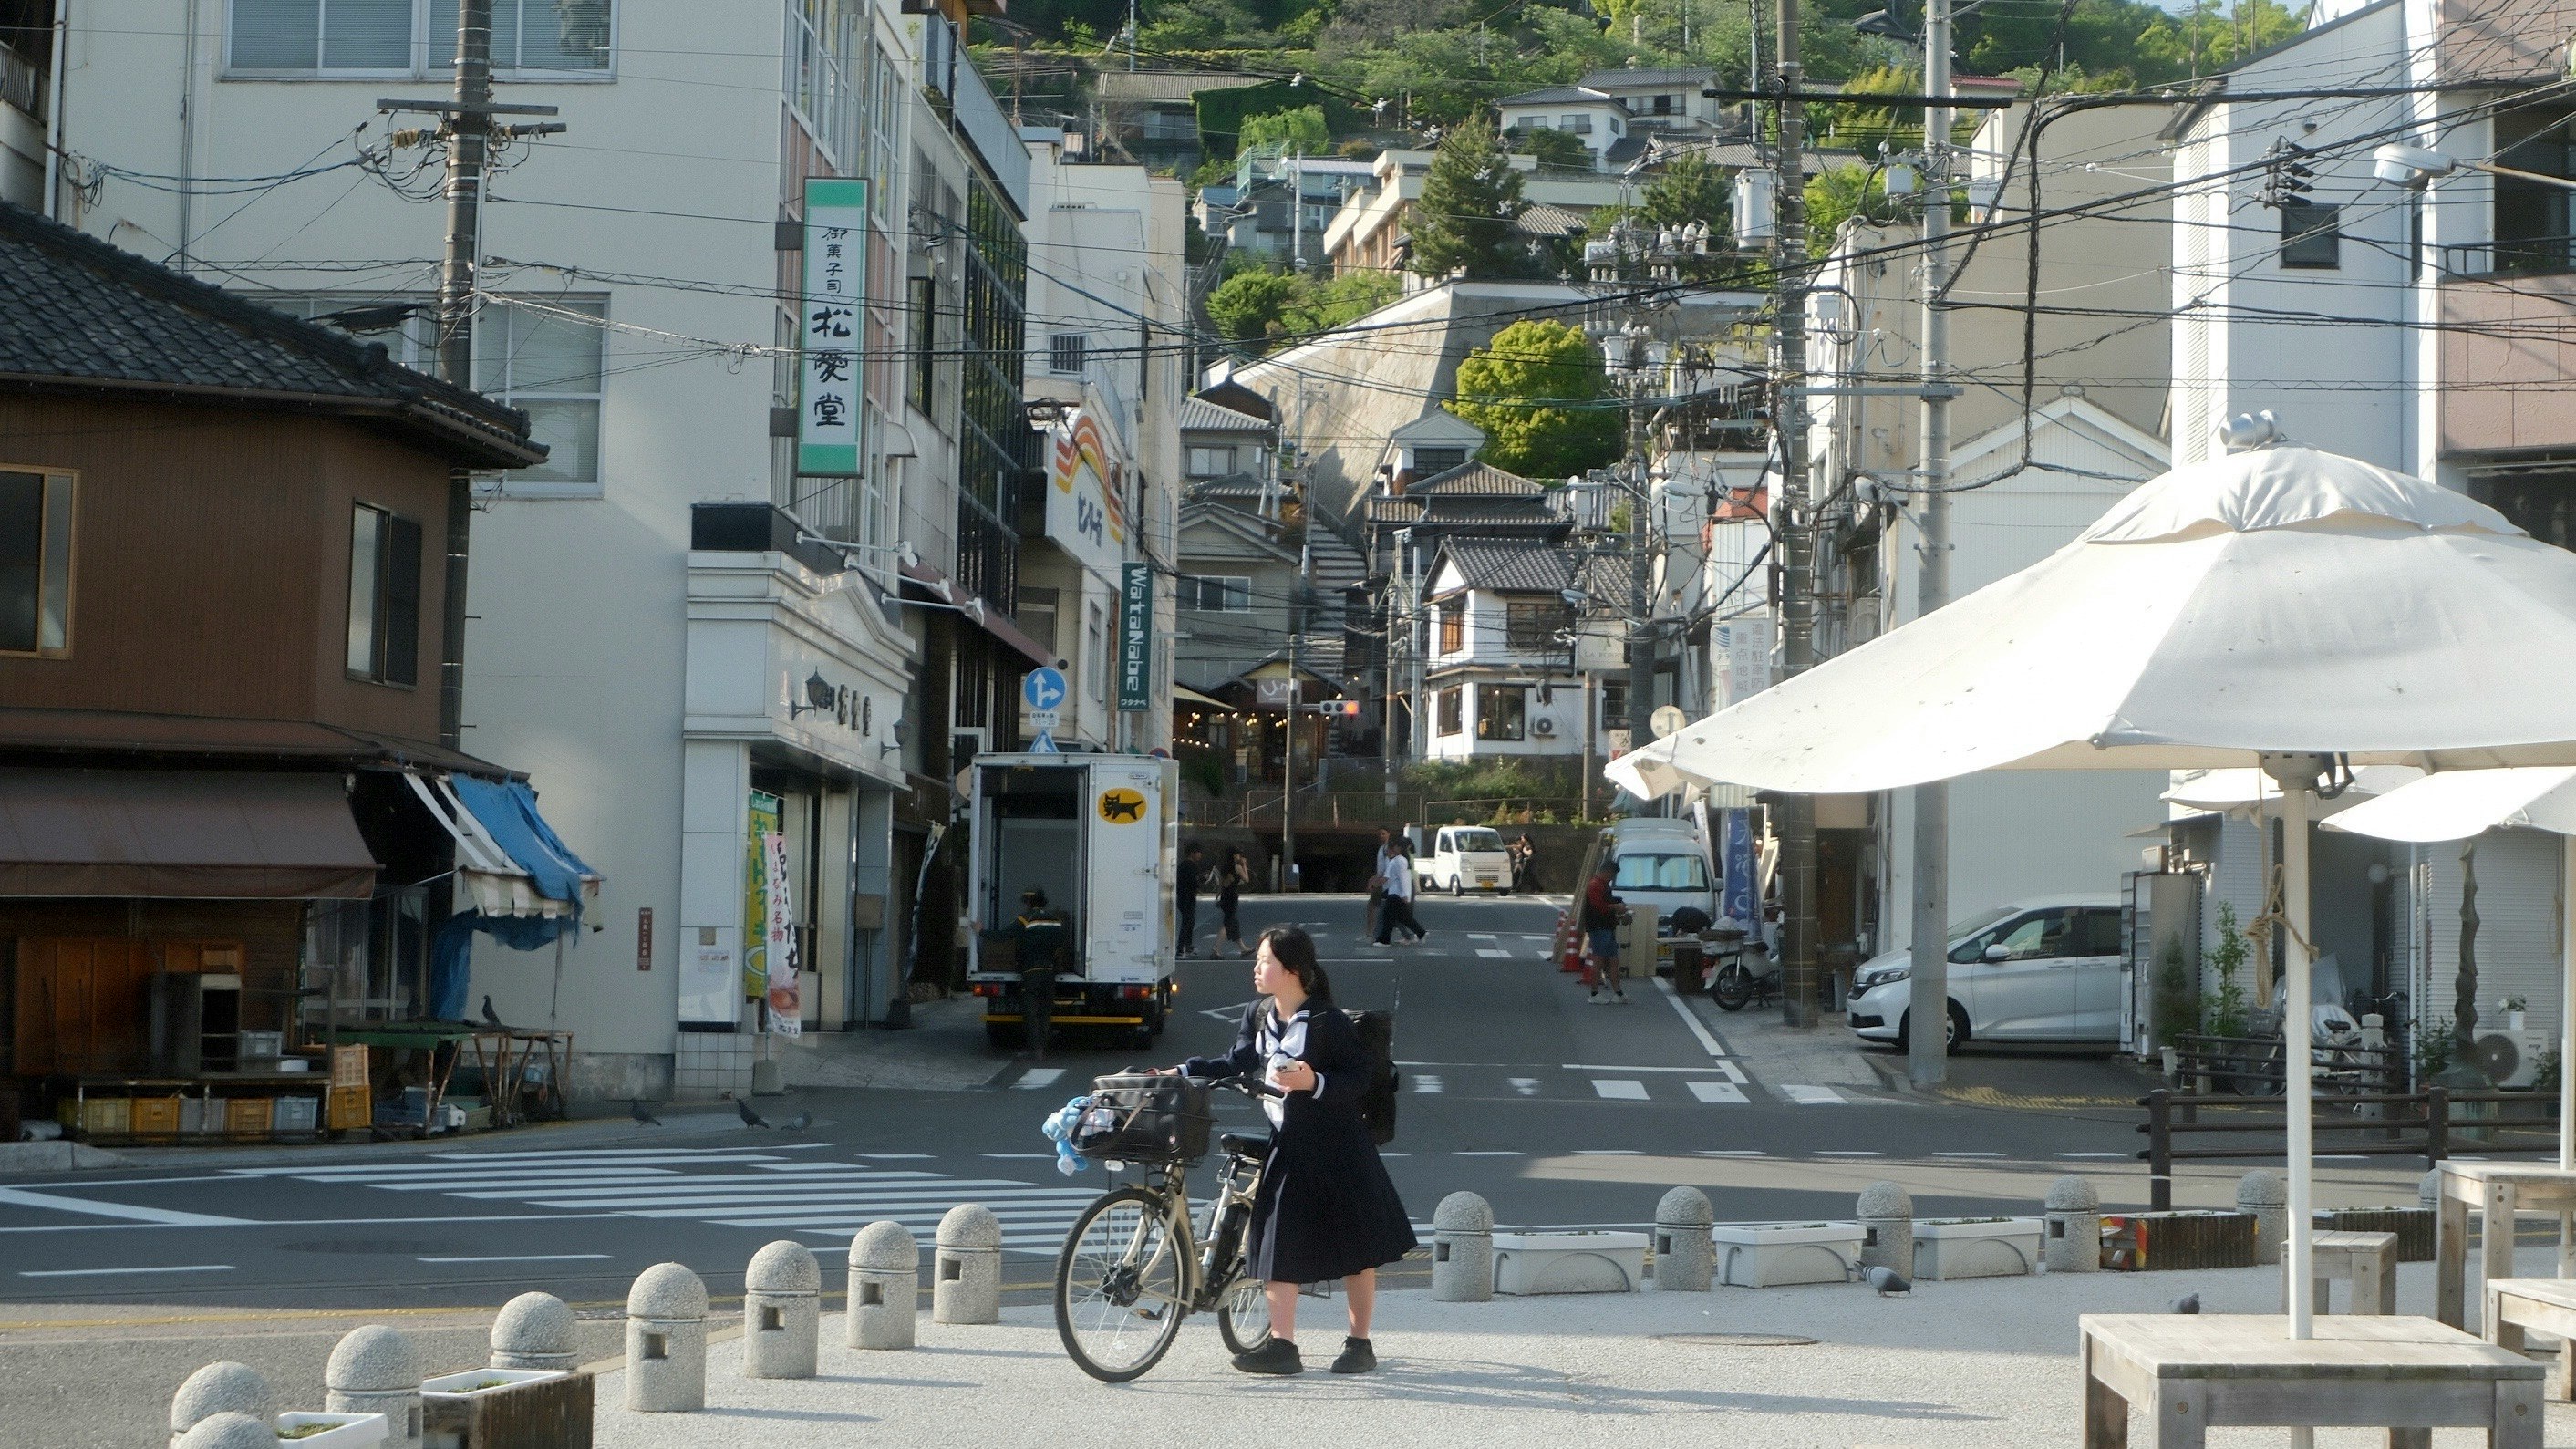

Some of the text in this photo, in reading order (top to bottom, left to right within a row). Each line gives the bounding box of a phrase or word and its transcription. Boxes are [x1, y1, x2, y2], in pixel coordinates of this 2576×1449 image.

[822, 227, 848, 294] 御菓子司
[1126, 566, 1147, 691] WataNabe
[1751, 623, 1764, 691] 違法駐車防
